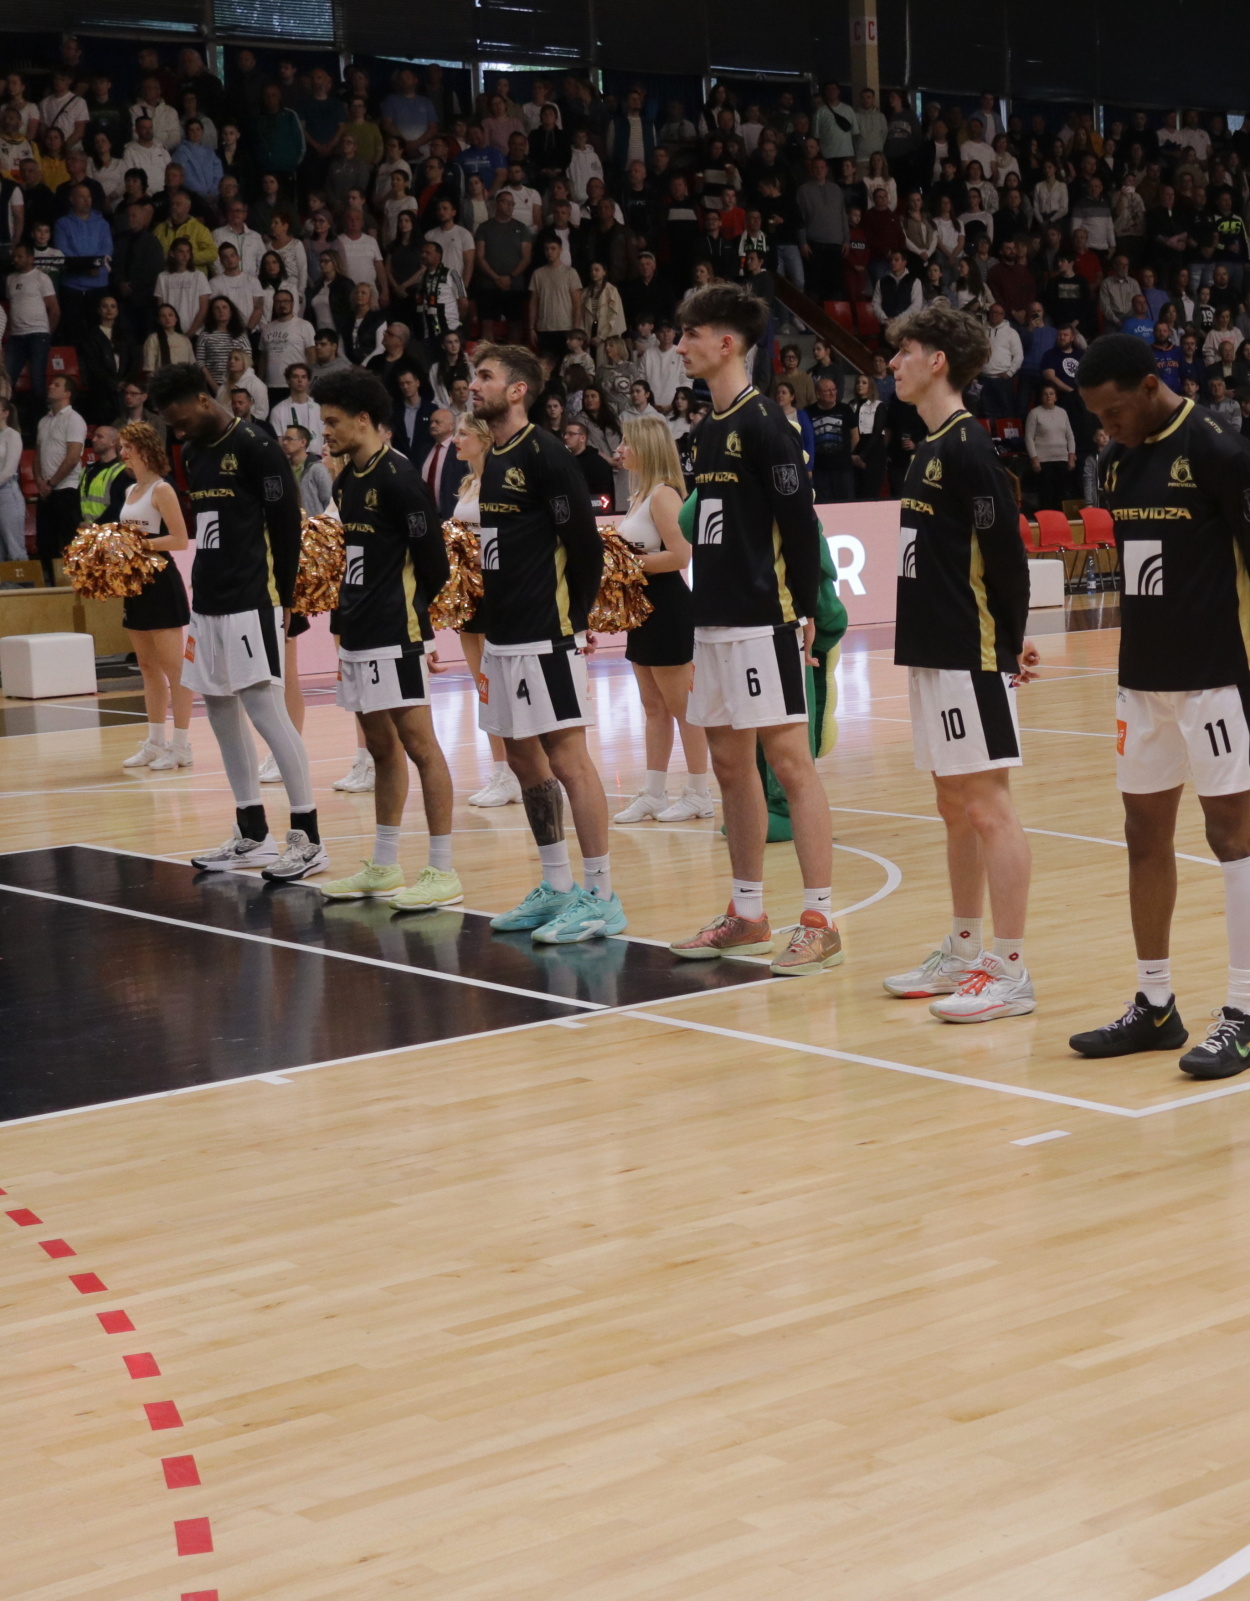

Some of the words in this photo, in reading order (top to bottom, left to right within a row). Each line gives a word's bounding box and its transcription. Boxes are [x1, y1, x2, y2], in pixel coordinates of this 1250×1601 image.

[867, 20, 876, 41] C
[241, 634, 254, 659] 1
[368, 659, 381, 685] 3
[746, 667, 763, 698] 6
[516, 678, 532, 706] 4
[940, 707, 967, 742] 10
[1204, 718, 1233, 758] 11
